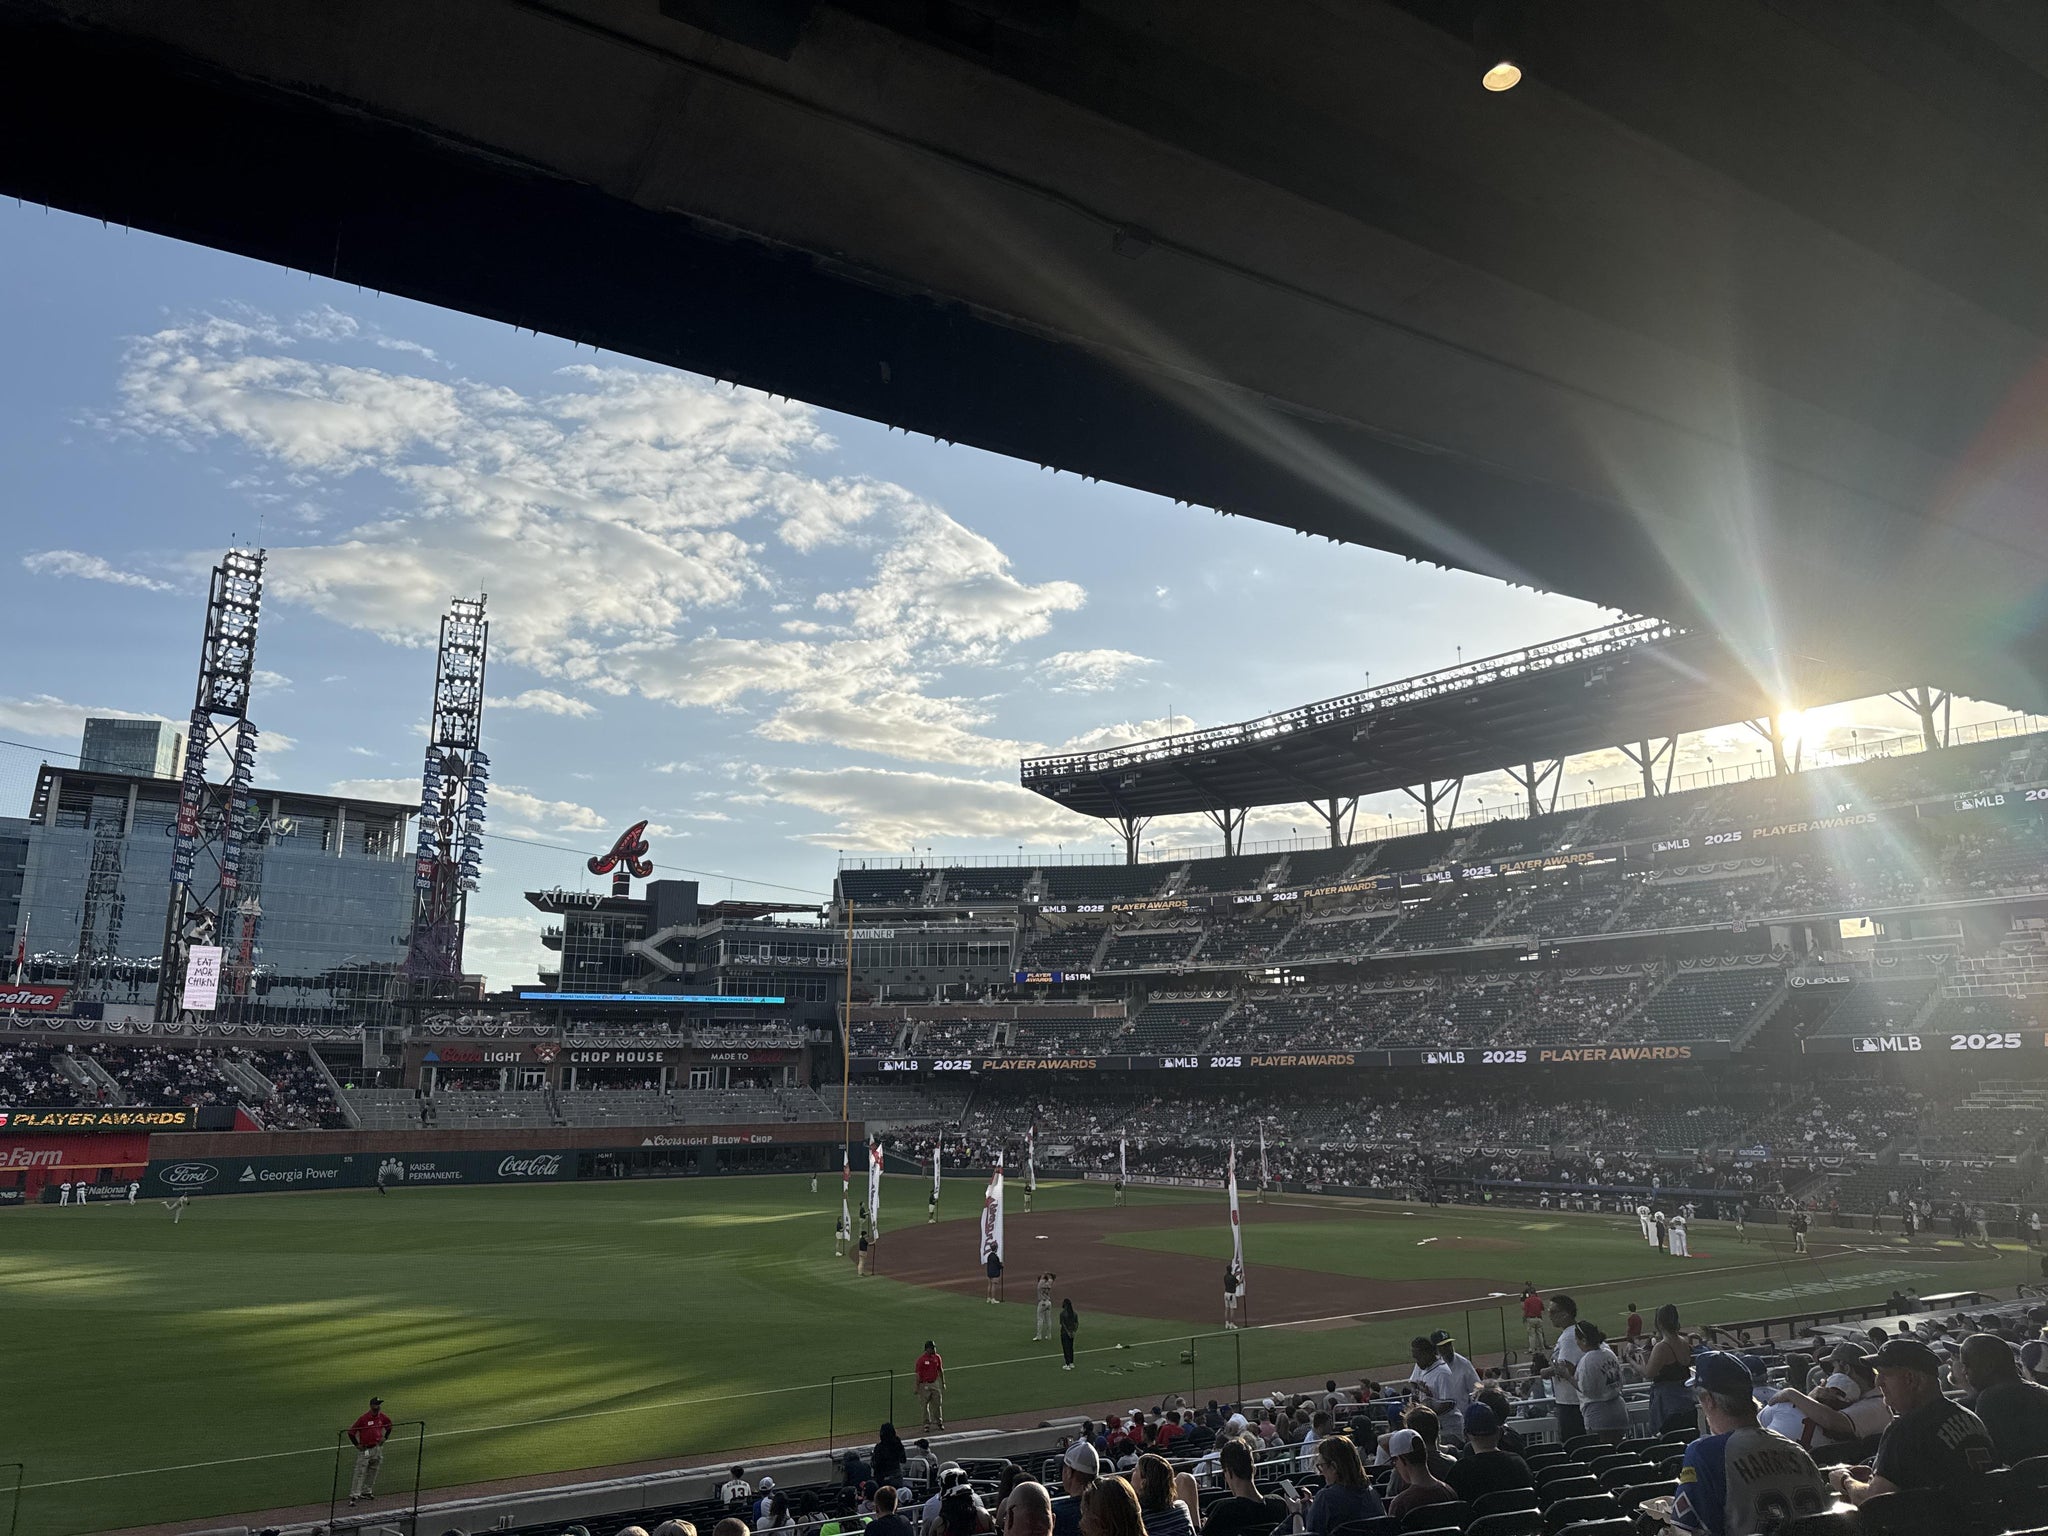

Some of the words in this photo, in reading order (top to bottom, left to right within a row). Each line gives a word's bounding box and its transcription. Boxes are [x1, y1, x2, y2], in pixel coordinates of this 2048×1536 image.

[1974, 794, 2006, 808] MLB
[180, 822, 194, 833] 1957
[1666, 838, 1690, 850] MLB
[1704, 831, 1742, 845] 2025
[1752, 822, 1807, 838] PLAYER
[1809, 812, 1878, 831] AWARDS
[226, 845, 240, 856] 1982
[224, 860, 238, 871] 1992
[1433, 870, 1452, 881] MLB
[1462, 866, 1492, 878] 2025
[1500, 860, 1543, 872] PLAYER
[1543, 852, 1594, 867] AWARDS
[462, 881, 476, 890] 2024
[540, 885, 604, 910] xfinity
[1245, 894, 1262, 902] MLB
[1273, 892, 1298, 901] 2025
[1304, 887, 1338, 898] PLAYER
[1338, 882, 1377, 894] AWARDS
[1077, 904, 1104, 912] 2025
[1112, 902, 1148, 912] PLAYER
[1148, 900, 1188, 910] AWARDS
[856, 930, 894, 938] MILNER
[197, 958, 213, 966] EAT
[194, 967, 212, 976] MOR
[188, 976, 216, 987] CHIKIN
[1806, 976, 1850, 985] LEXUS
[1880, 1036, 1922, 1051] MLB
[1950, 1033, 2022, 1050] 2025
[484, 1052, 522, 1062] LIGHT
[570, 1052, 610, 1062] CHOP
[616, 1052, 664, 1062] HOUSE
[1439, 1051, 1465, 1064] MLB
[1482, 1050, 1527, 1063] 2025
[1540, 1049, 1606, 1062] PLAYER
[1608, 1046, 1692, 1060] AWARDS
[894, 1060, 918, 1070] MLB
[934, 1060, 972, 1070] 2025
[983, 1060, 1036, 1070] PLAYER
[1038, 1059, 1097, 1069] AWARDS
[1175, 1057, 1198, 1068] MLB
[1210, 1056, 1242, 1068] 2025
[1250, 1056, 1296, 1066] PLAYER
[1298, 1054, 1355, 1066] AWARDS
[13, 1113, 97, 1126] PLAYER
[98, 1112, 188, 1126] AWARDS
[654, 1134, 682, 1146] Coors
[682, 1137, 707, 1145] LIGHT
[712, 1136, 740, 1144] BELOW
[750, 1135, 773, 1143] CHOP
[8, 1148, 63, 1166] Farm
[498, 1154, 563, 1176] Coca-Cola
[170, 1166, 208, 1182] Ford
[260, 1168, 303, 1182] Georgia
[306, 1168, 339, 1179] Power
[409, 1171, 460, 1180] PERMANENTE
[88, 1185, 128, 1195] National
[731, 1488, 745, 1498] 13
